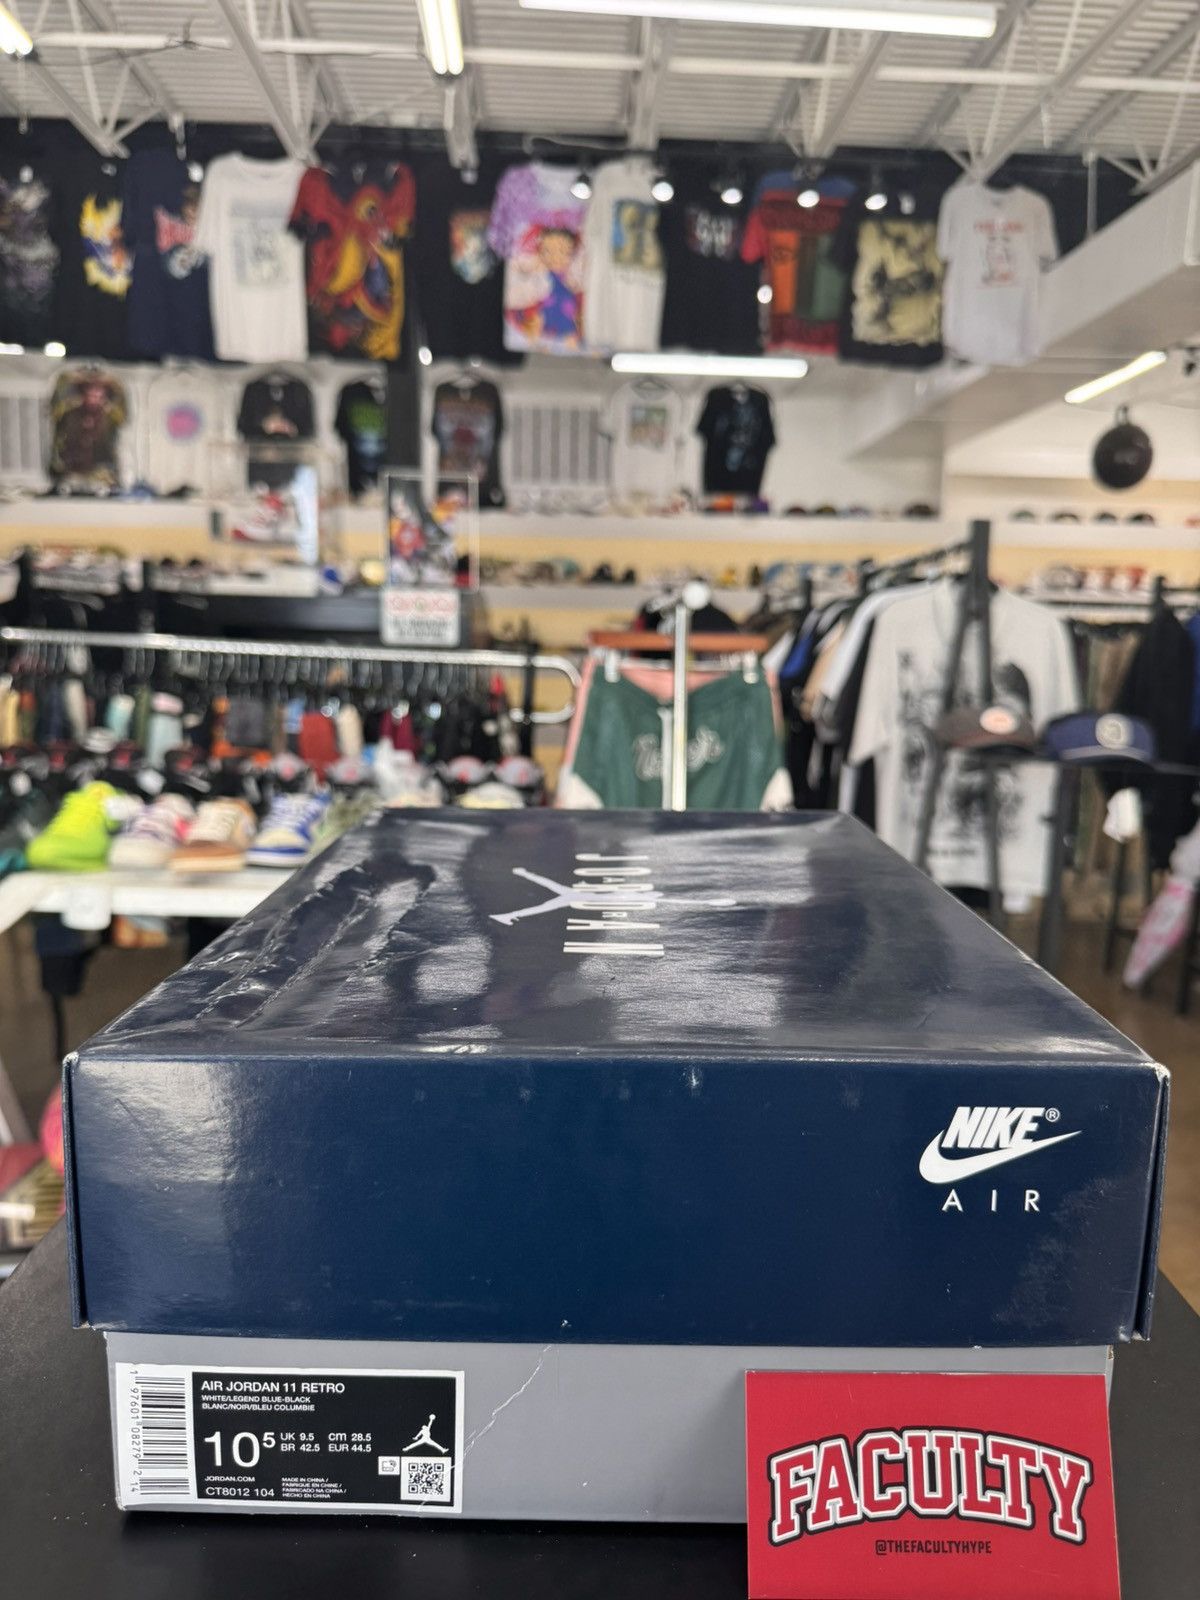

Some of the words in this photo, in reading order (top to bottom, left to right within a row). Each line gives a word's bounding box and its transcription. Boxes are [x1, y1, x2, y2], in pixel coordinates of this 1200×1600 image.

[563, 853, 665, 955] JORDAN
[941, 1106, 1046, 1149] NIKE
[942, 1188, 1040, 1212] AIR
[201, 1380, 223, 1391] AIR
[226, 1381, 280, 1392] JORDAN
[283, 1382, 297, 1393] 11
[301, 1382, 345, 1394] RETRO
[202, 1403, 272, 1411] BLANC/NOIR/BLEU
[274, 1404, 315, 1412] COLUMBIE
[280, 1432, 295, 1441] UK
[299, 1432, 315, 1441] 9.5
[351, 1433, 372, 1442] 28.5
[280, 1443, 296, 1451] BR
[299, 1443, 320, 1452] 42.5
[328, 1444, 349, 1452] EUR
[351, 1444, 372, 1452] 44.5
[204, 1475, 255, 1483] JORDAN.COM
[767, 1425, 1094, 1546] FACULTY
[205, 1486, 250, 1497] CT8012
[253, 1488, 275, 1497] 104
[875, 1539, 992, 1556] @THEFACULTYHYPE
